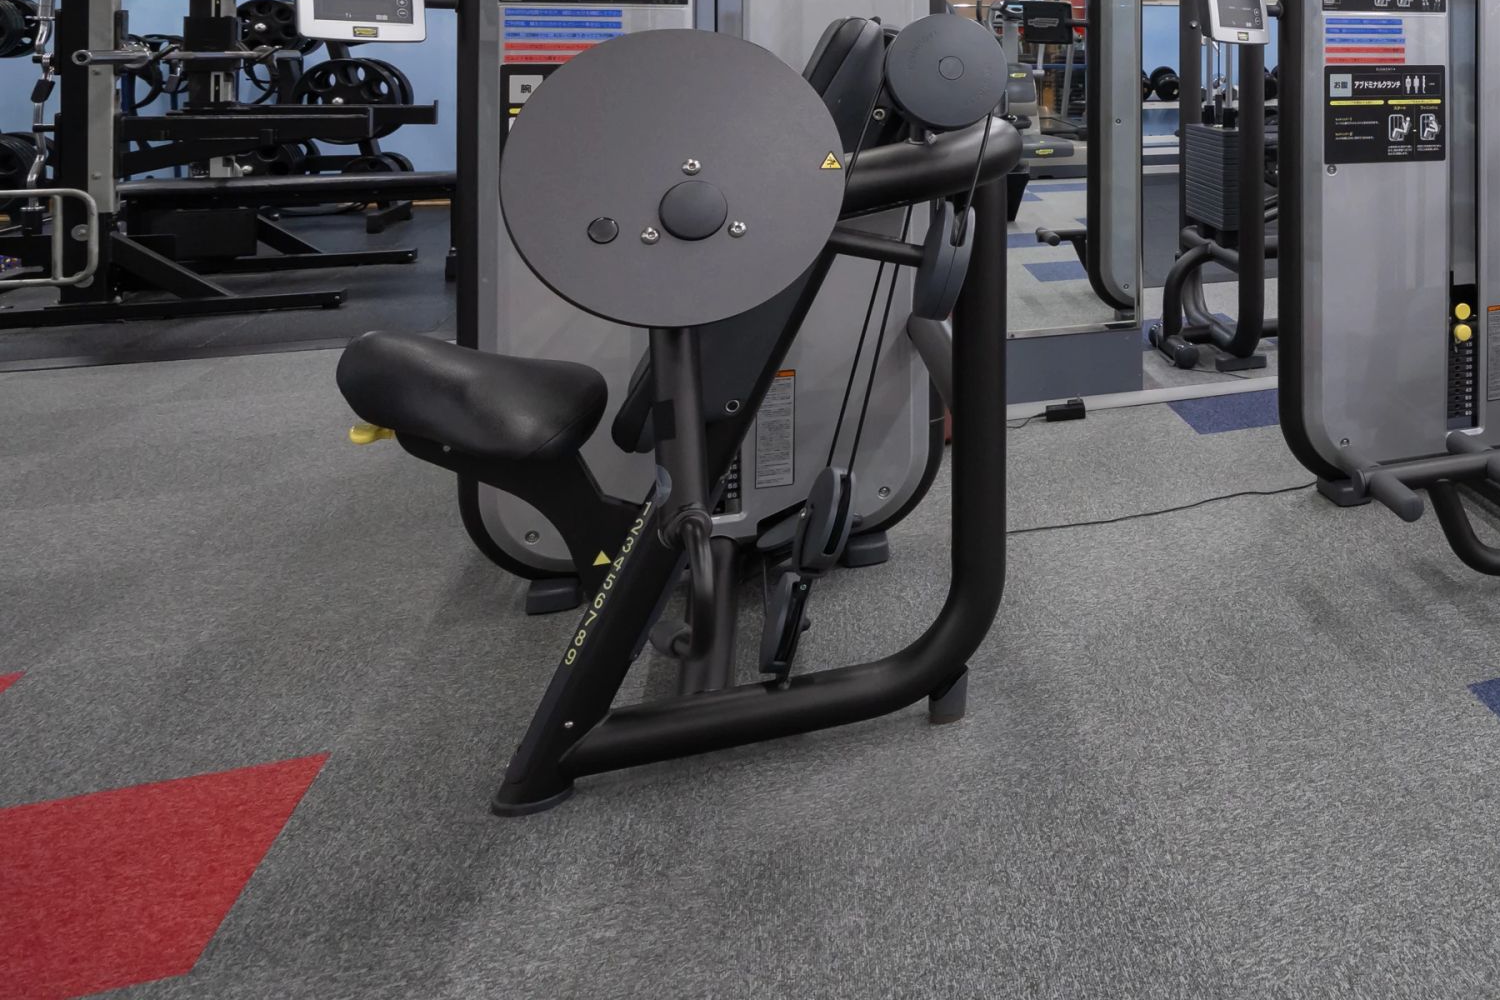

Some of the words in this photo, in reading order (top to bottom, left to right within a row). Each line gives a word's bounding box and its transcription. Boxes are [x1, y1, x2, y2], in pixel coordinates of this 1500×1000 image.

[643, 501, 652, 516] 1
[630, 518, 644, 536] 2
[622, 536, 634, 553] 3
[613, 556, 625, 571] 4
[603, 573, 616, 590] 5
[594, 592, 606, 609] 6
[584, 609, 598, 626] 7
[574, 629, 587, 647] 8
[565, 648, 577, 665] 9
